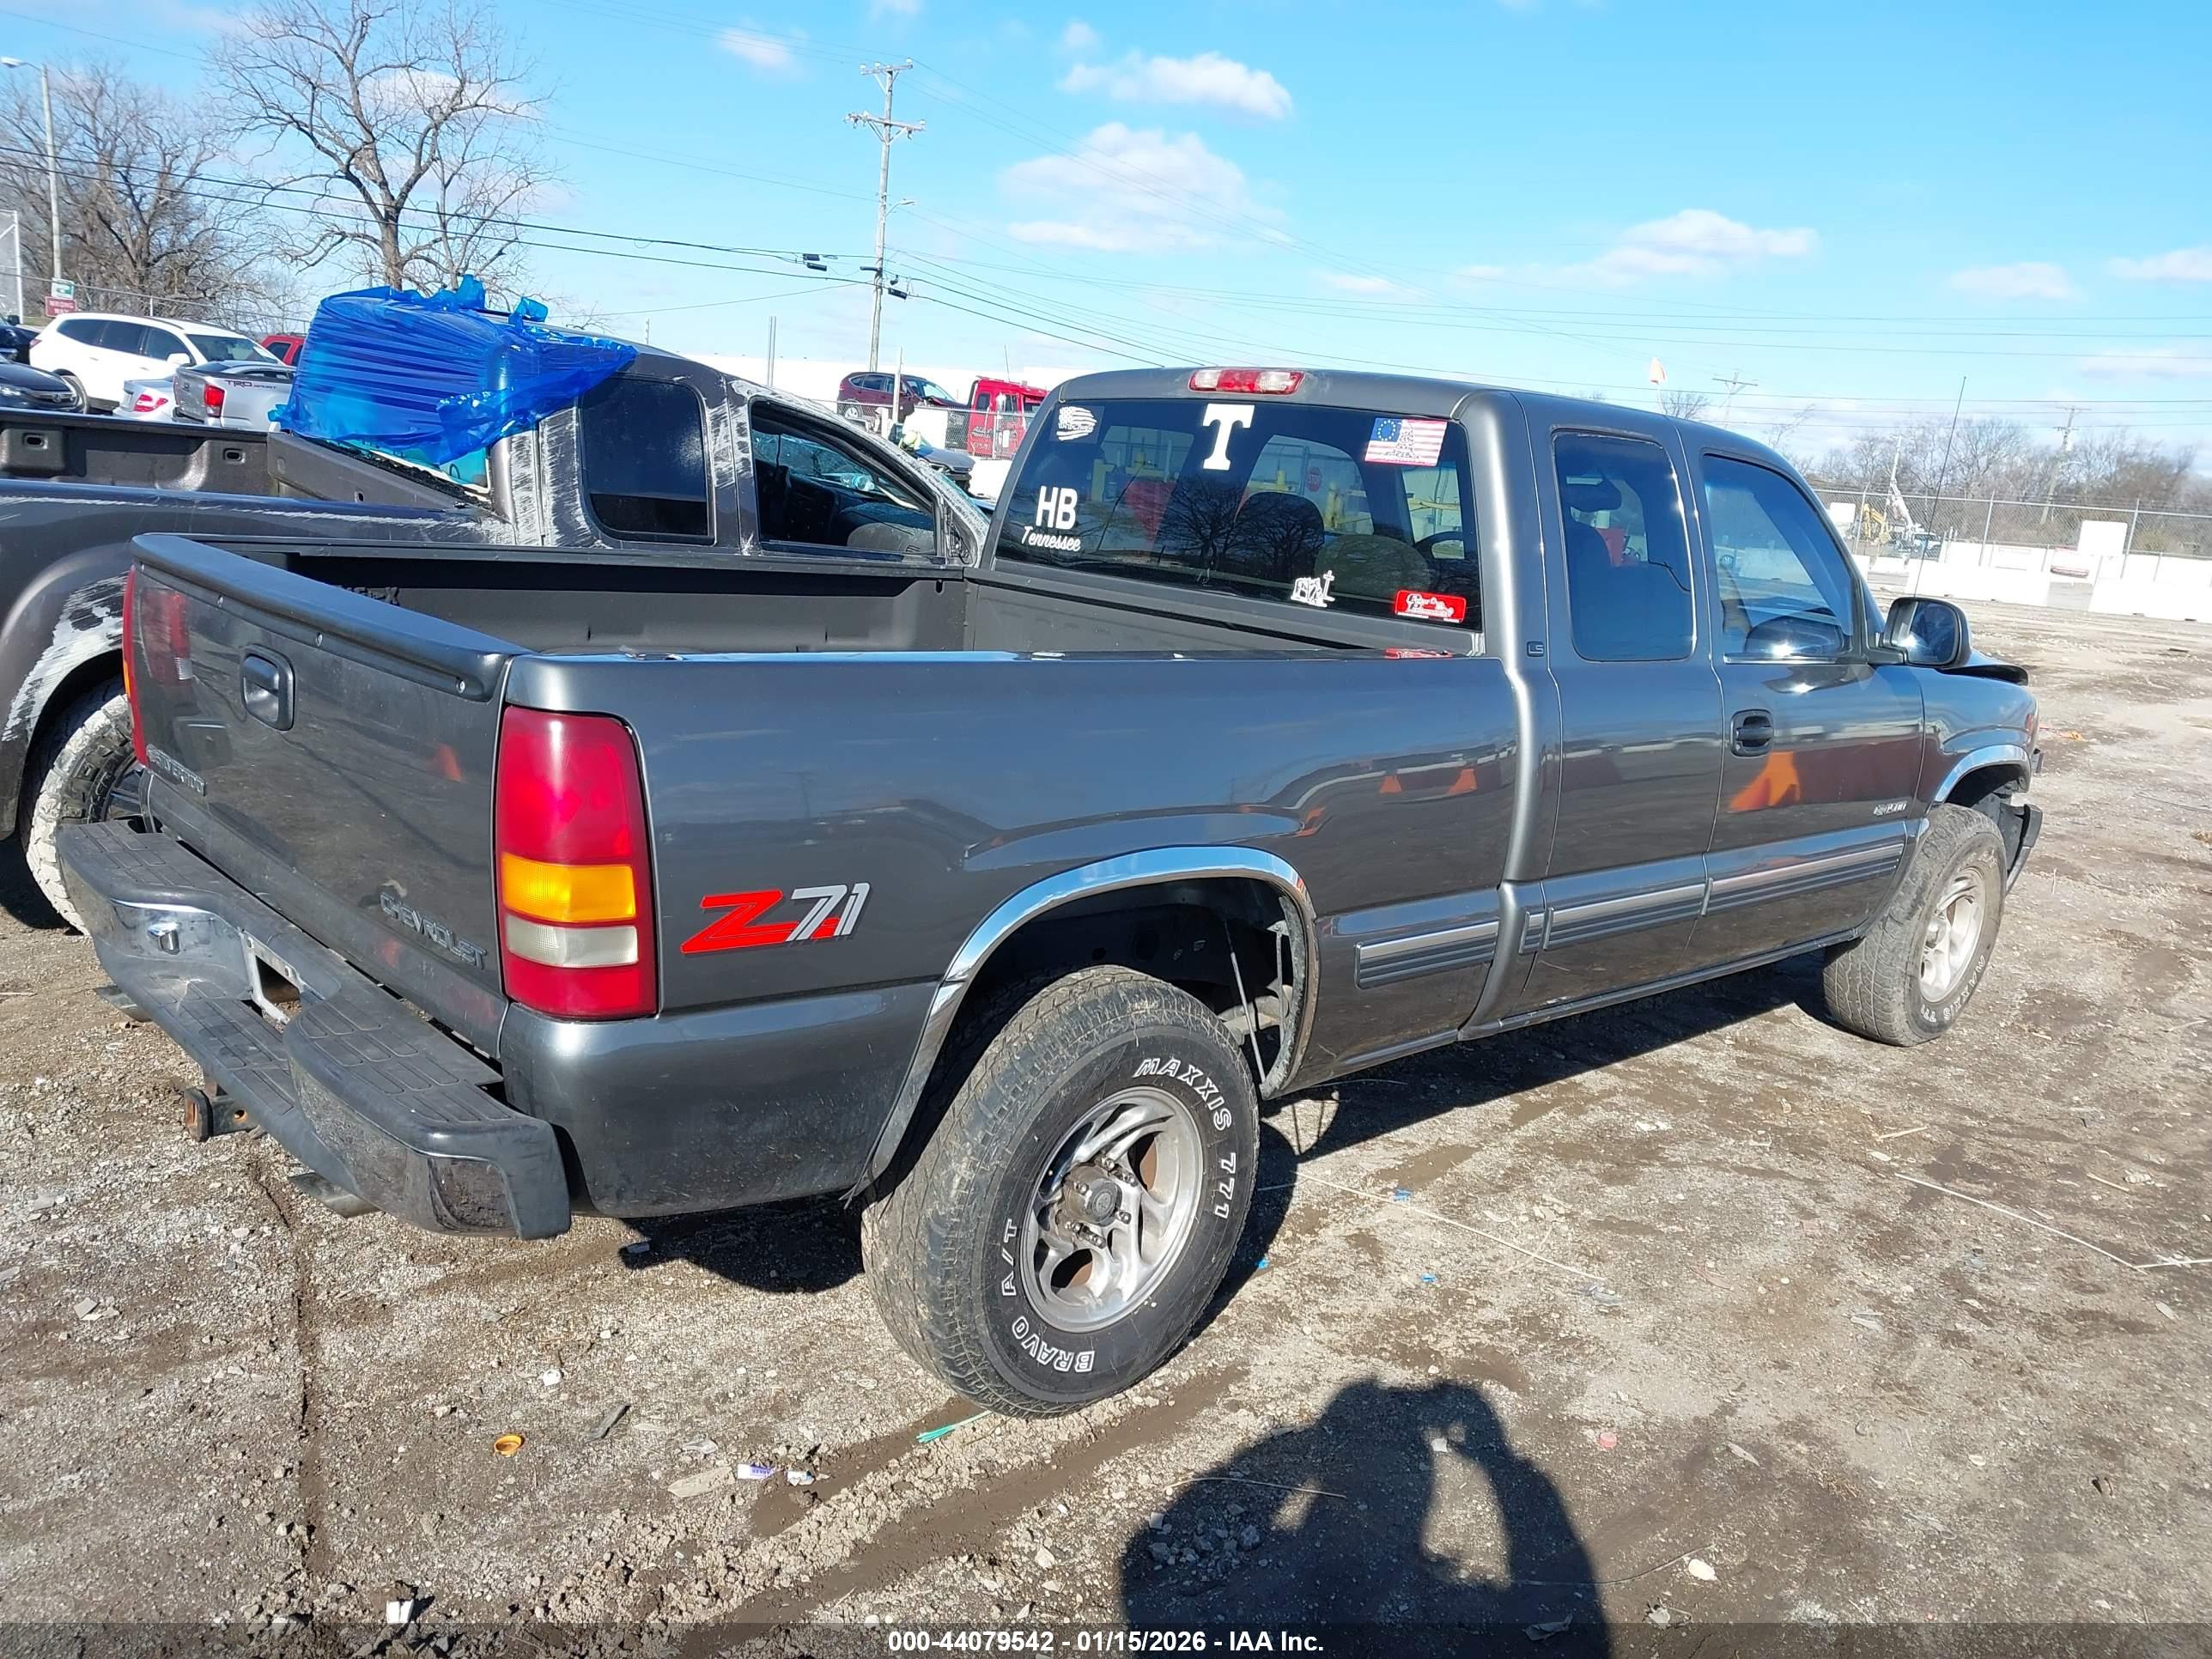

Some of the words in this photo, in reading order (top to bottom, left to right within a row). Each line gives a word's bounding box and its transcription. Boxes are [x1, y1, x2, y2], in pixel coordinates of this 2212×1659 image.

[49, 301, 75, 309] WRONG
[1202, 404, 1255, 471] T
[1021, 526, 1081, 551] Tennessee
[1036, 485, 1078, 530] HB
[1528, 644, 1544, 653] LS
[380, 893, 487, 968] CHEVROLET
[680, 882, 870, 954] Z71
[1942, 955, 1985, 1021] MAXXIS
[1132, 1058, 1232, 1131] MAXXIS
[1214, 1152, 1237, 1218] 771
[1001, 1218, 1018, 1296] A/T
[1012, 1316, 1095, 1372] BRAVO
